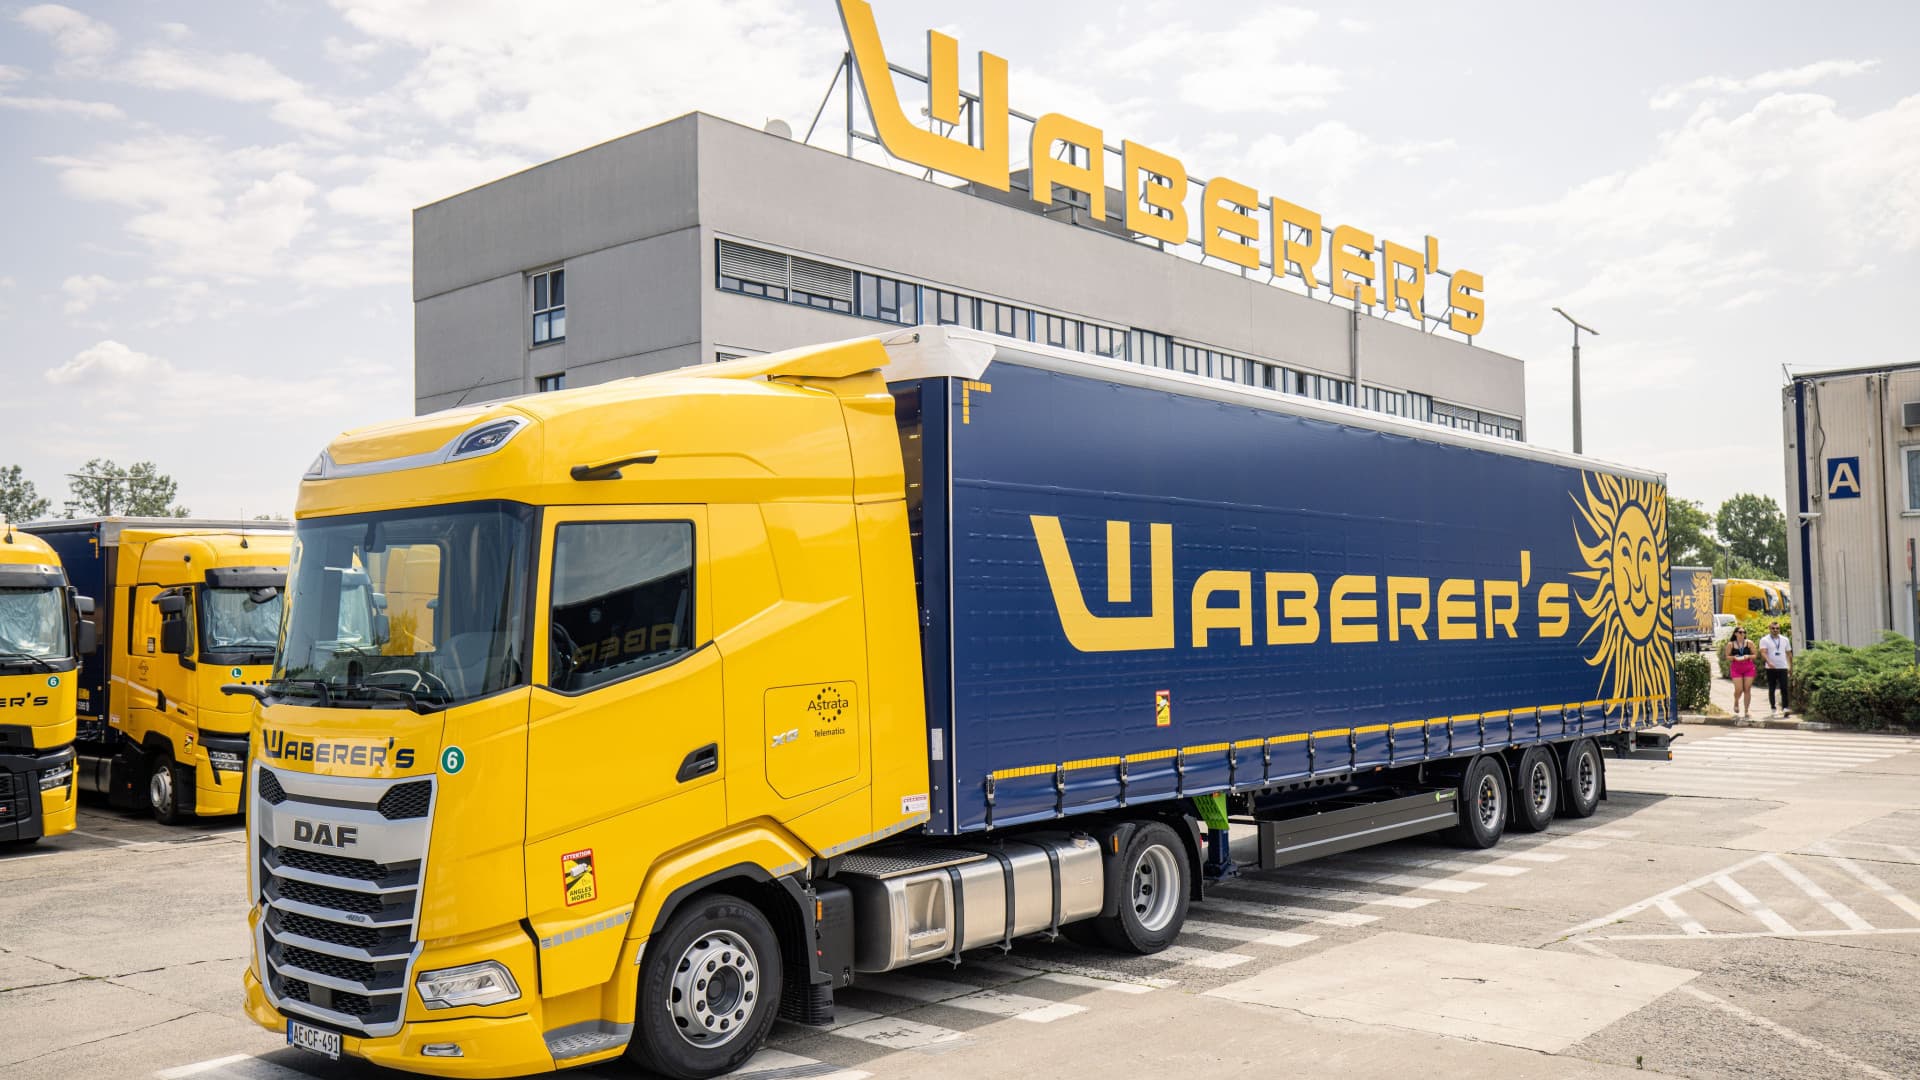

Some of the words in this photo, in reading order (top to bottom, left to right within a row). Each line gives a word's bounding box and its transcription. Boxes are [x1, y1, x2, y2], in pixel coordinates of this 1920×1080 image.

[837, 0, 1486, 336] WABERER'S
[1829, 462, 1860, 493] A
[1030, 514, 1570, 653] WABERER'S
[49, 677, 57, 686] 6
[807, 699, 849, 711] Astrata
[814, 728, 845, 737] Telematics
[263, 729, 415, 769] WABERER'S
[447, 751, 459, 769] 6
[294, 820, 358, 848] DAF
[570, 886, 592, 897] ANGLES
[571, 892, 592, 902] MORTS
